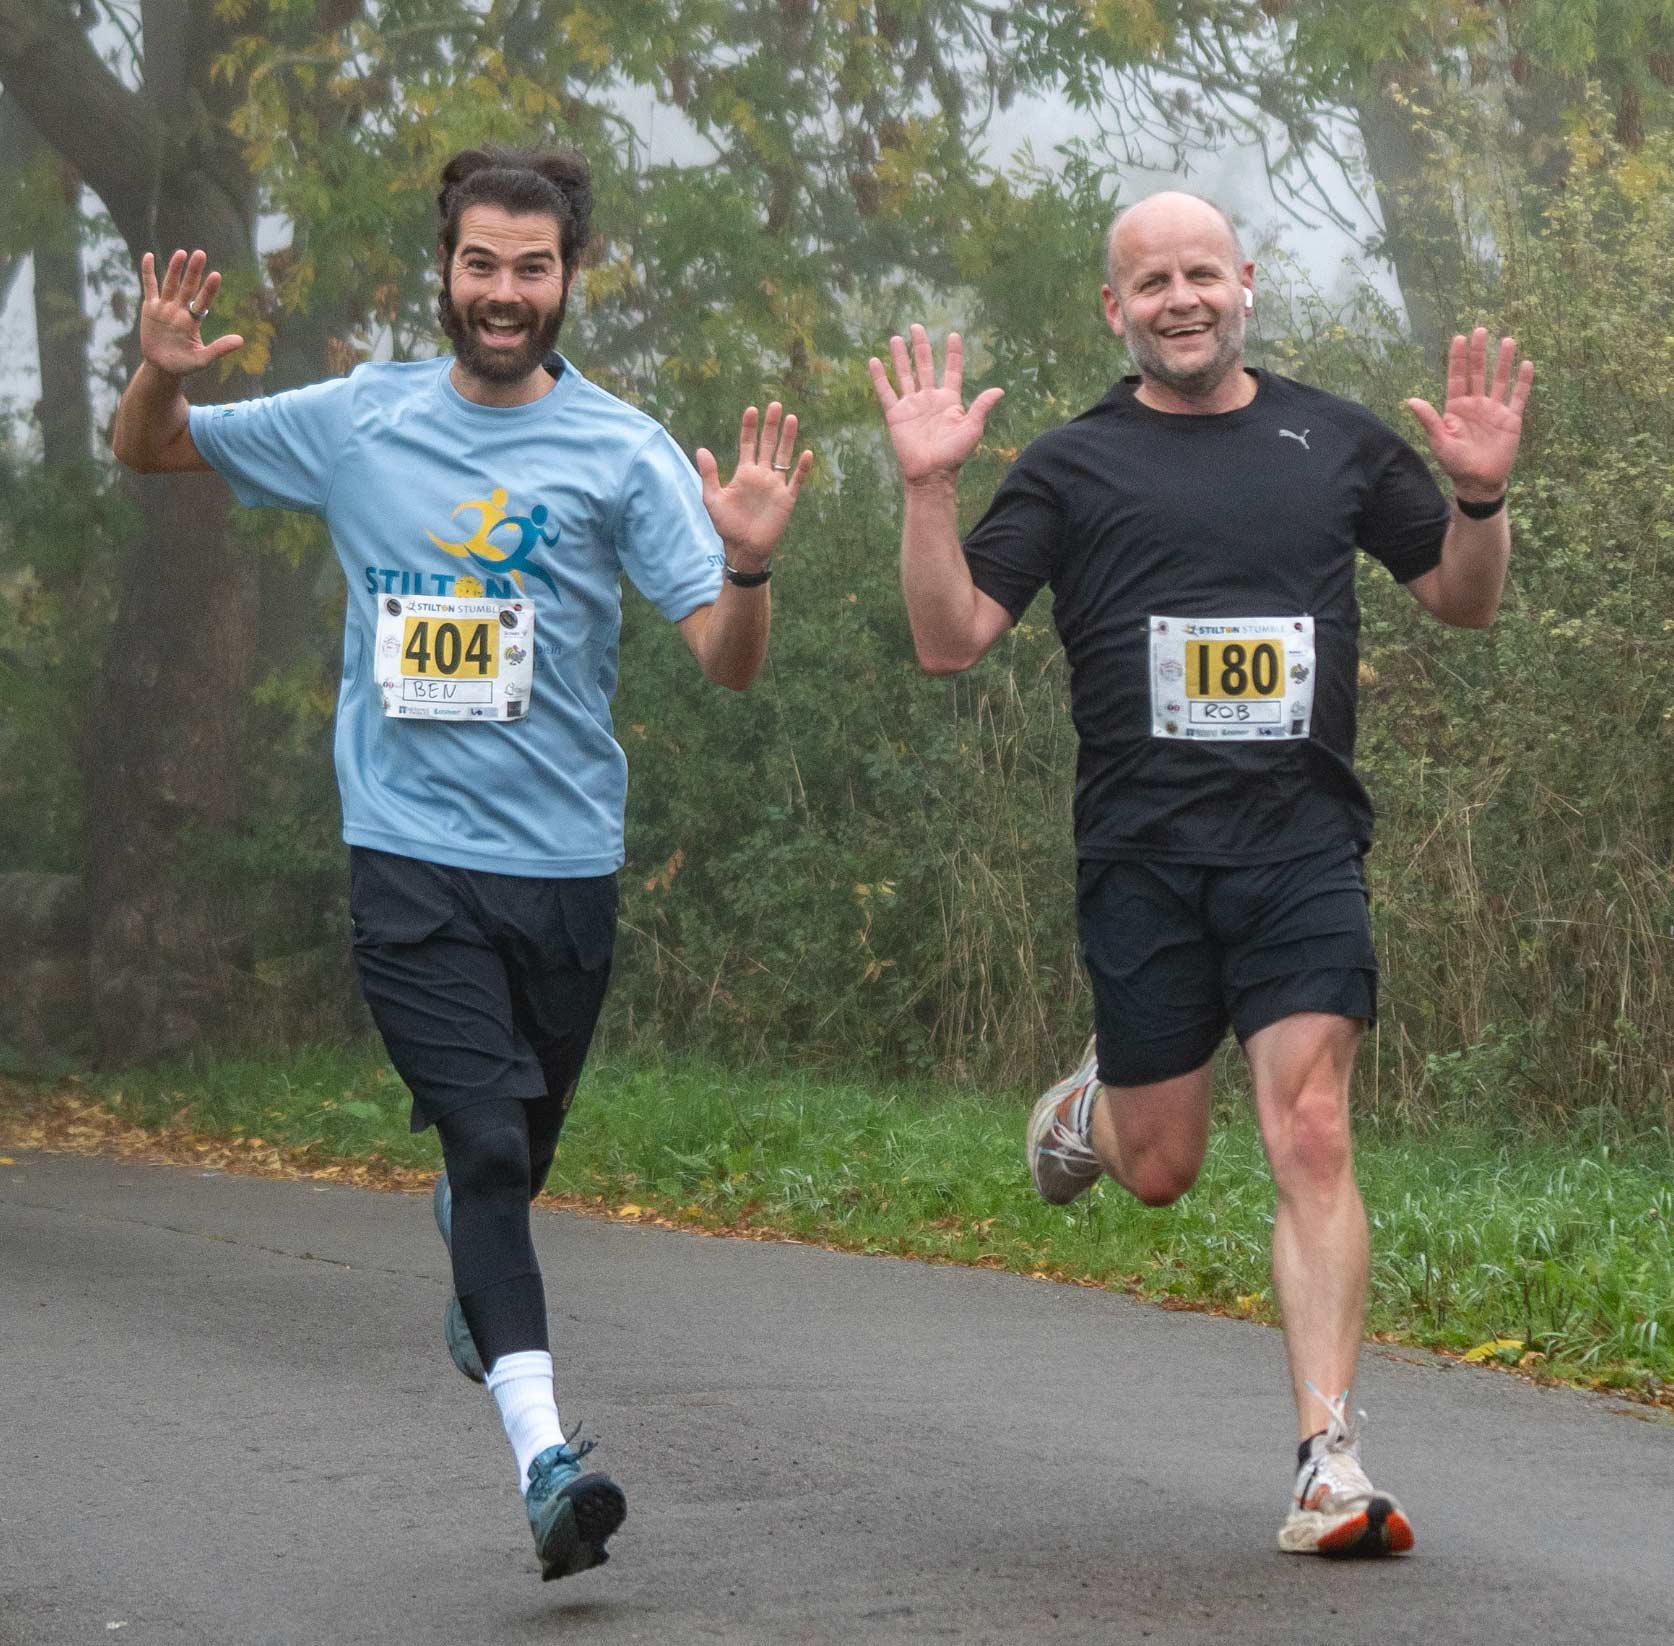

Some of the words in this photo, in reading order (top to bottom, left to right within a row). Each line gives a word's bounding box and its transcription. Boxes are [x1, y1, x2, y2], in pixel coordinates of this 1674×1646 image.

[418, 602, 455, 613] STILTON
[405, 621, 492, 675] 404
[1199, 642, 1279, 696] 180
[413, 681, 457, 699] BEN
[1204, 703, 1250, 721] ROB
